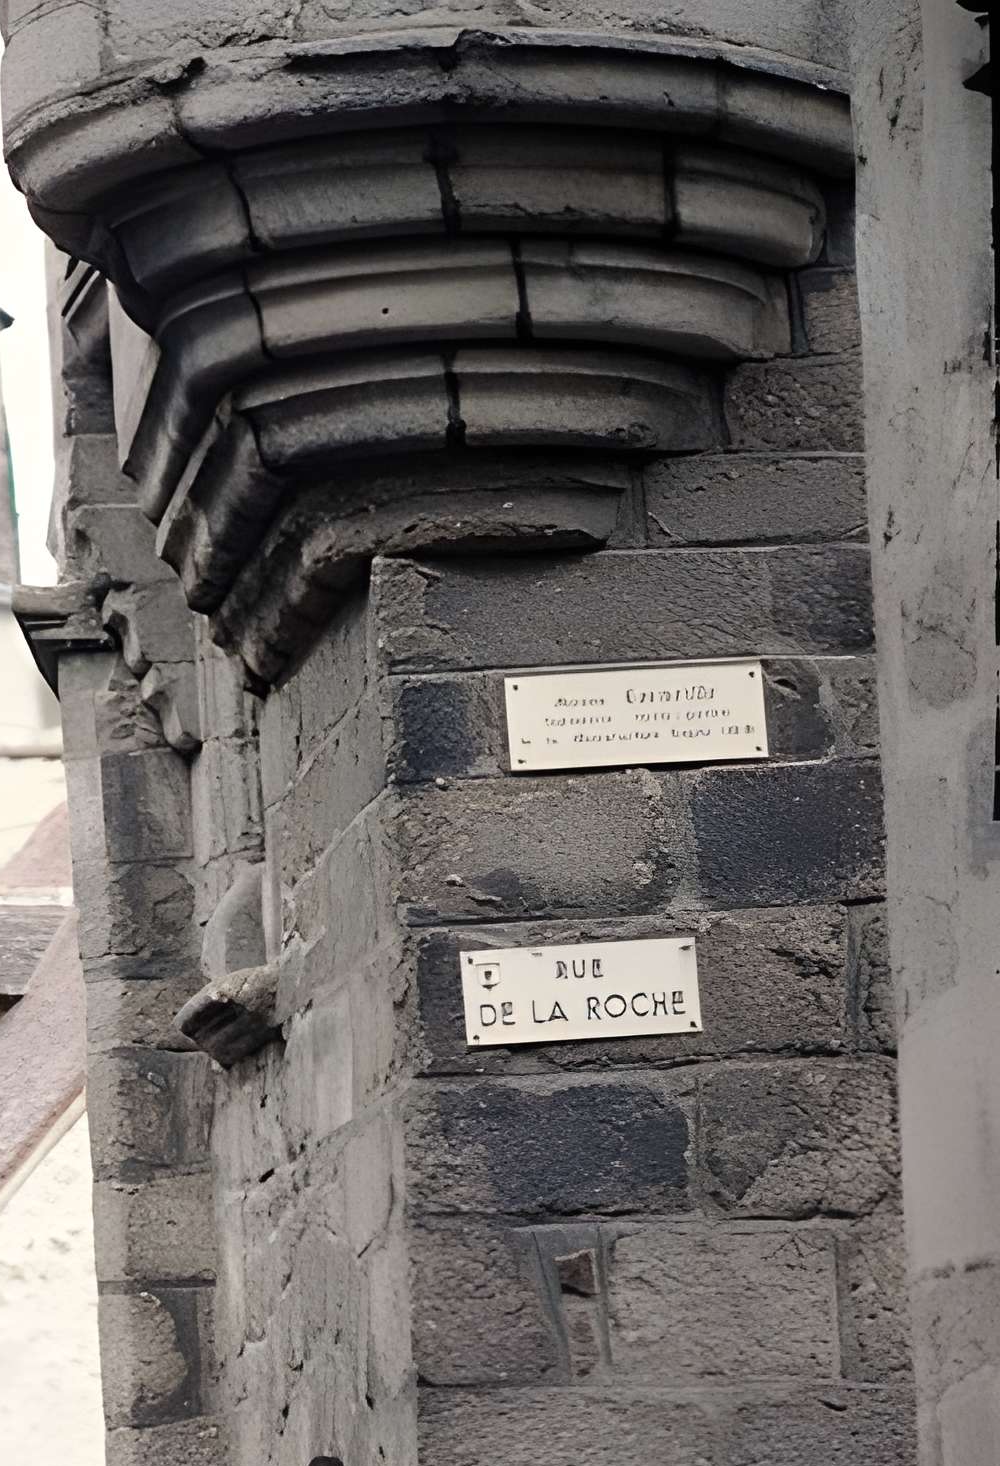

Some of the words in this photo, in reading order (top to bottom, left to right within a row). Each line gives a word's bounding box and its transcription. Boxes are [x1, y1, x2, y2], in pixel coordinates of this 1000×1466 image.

[555, 958, 604, 979] RUE
[479, 1001, 516, 1027] DE
[532, 999, 569, 1024] LA
[586, 990, 686, 1021] ROCHE
